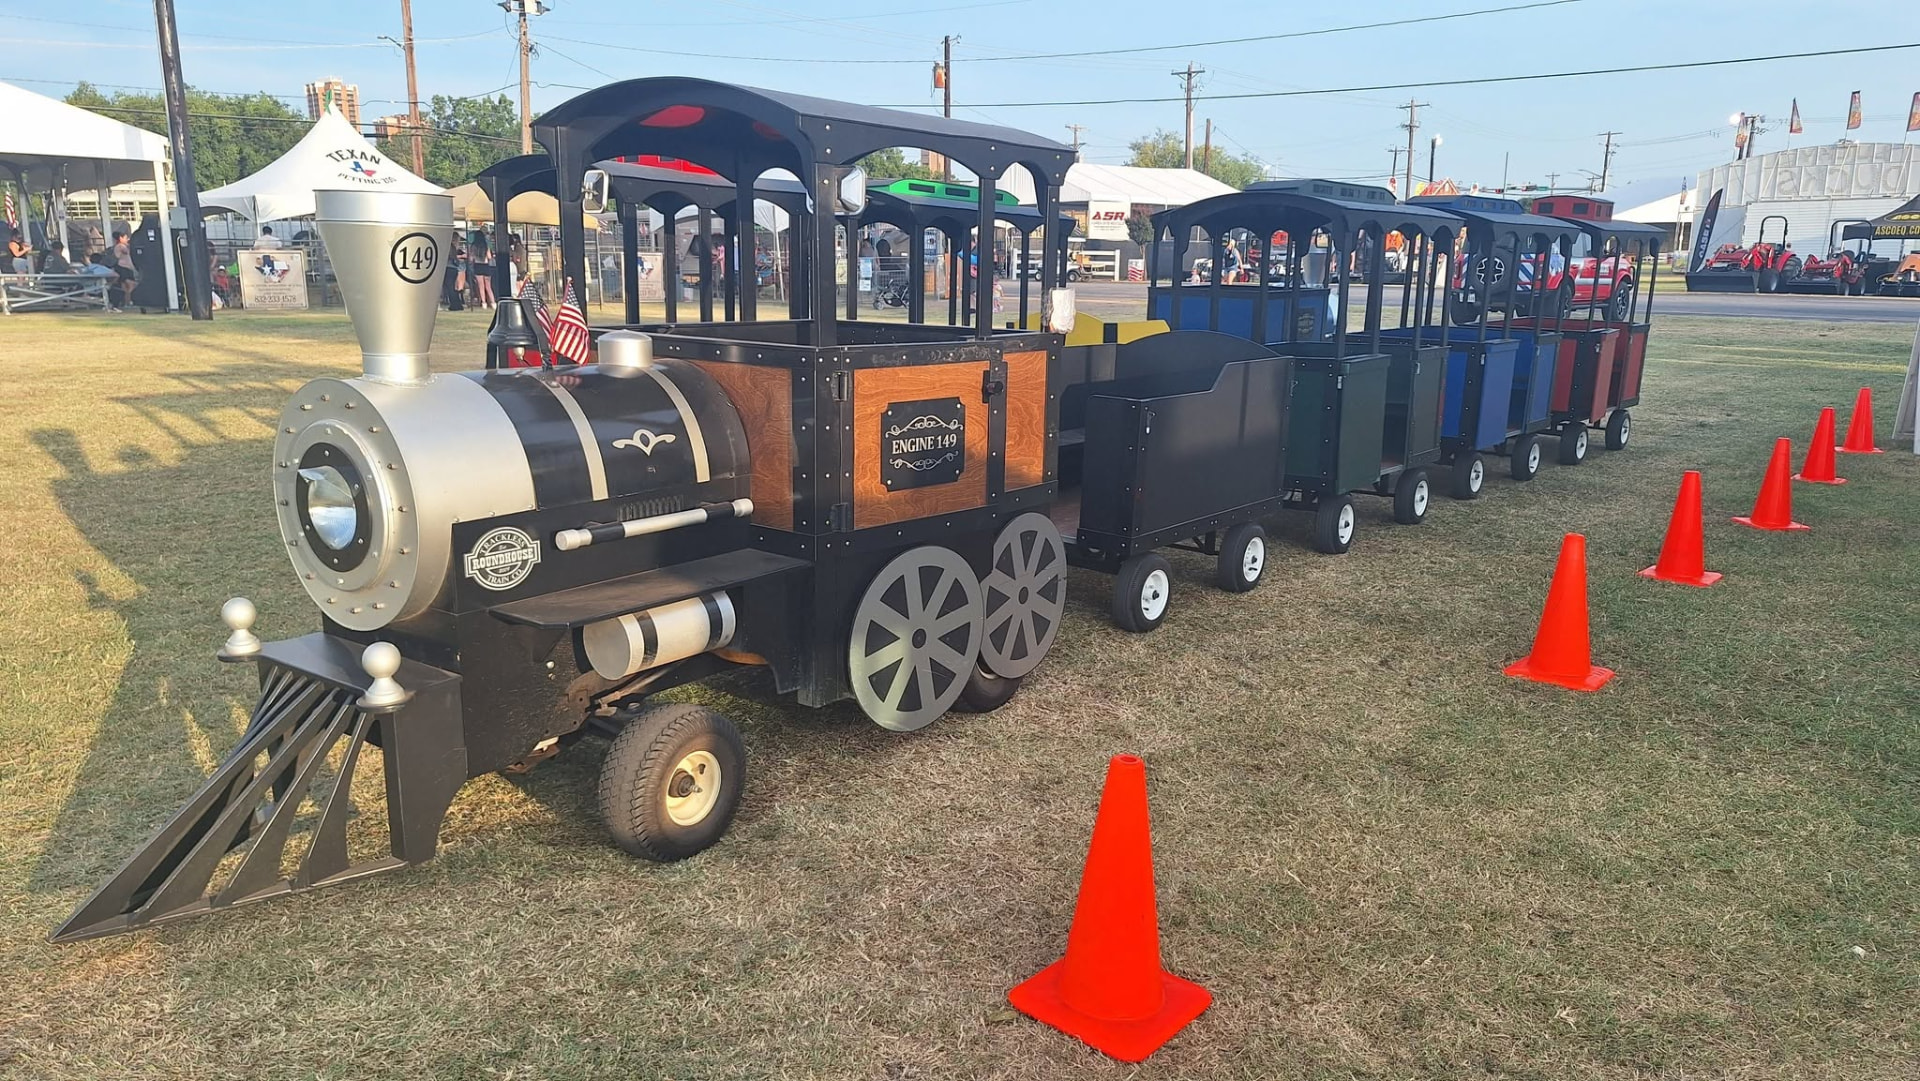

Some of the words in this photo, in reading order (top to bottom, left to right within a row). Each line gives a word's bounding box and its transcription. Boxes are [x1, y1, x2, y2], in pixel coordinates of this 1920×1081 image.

[326, 149, 380, 165] TEXAN
[338, 173, 380, 184] PETTING
[1092, 211, 1125, 221] ASR
[1875, 225, 1920, 236] ASCOEQ.CO
[399, 246, 433, 270] 149
[892, 436, 935, 454] ENGINE
[936, 433, 957, 449] 149
[479, 534, 525, 555] TRACKLESS
[472, 548, 534, 570] ROUNDHOUSE
[487, 574, 510, 584] TRAIN
